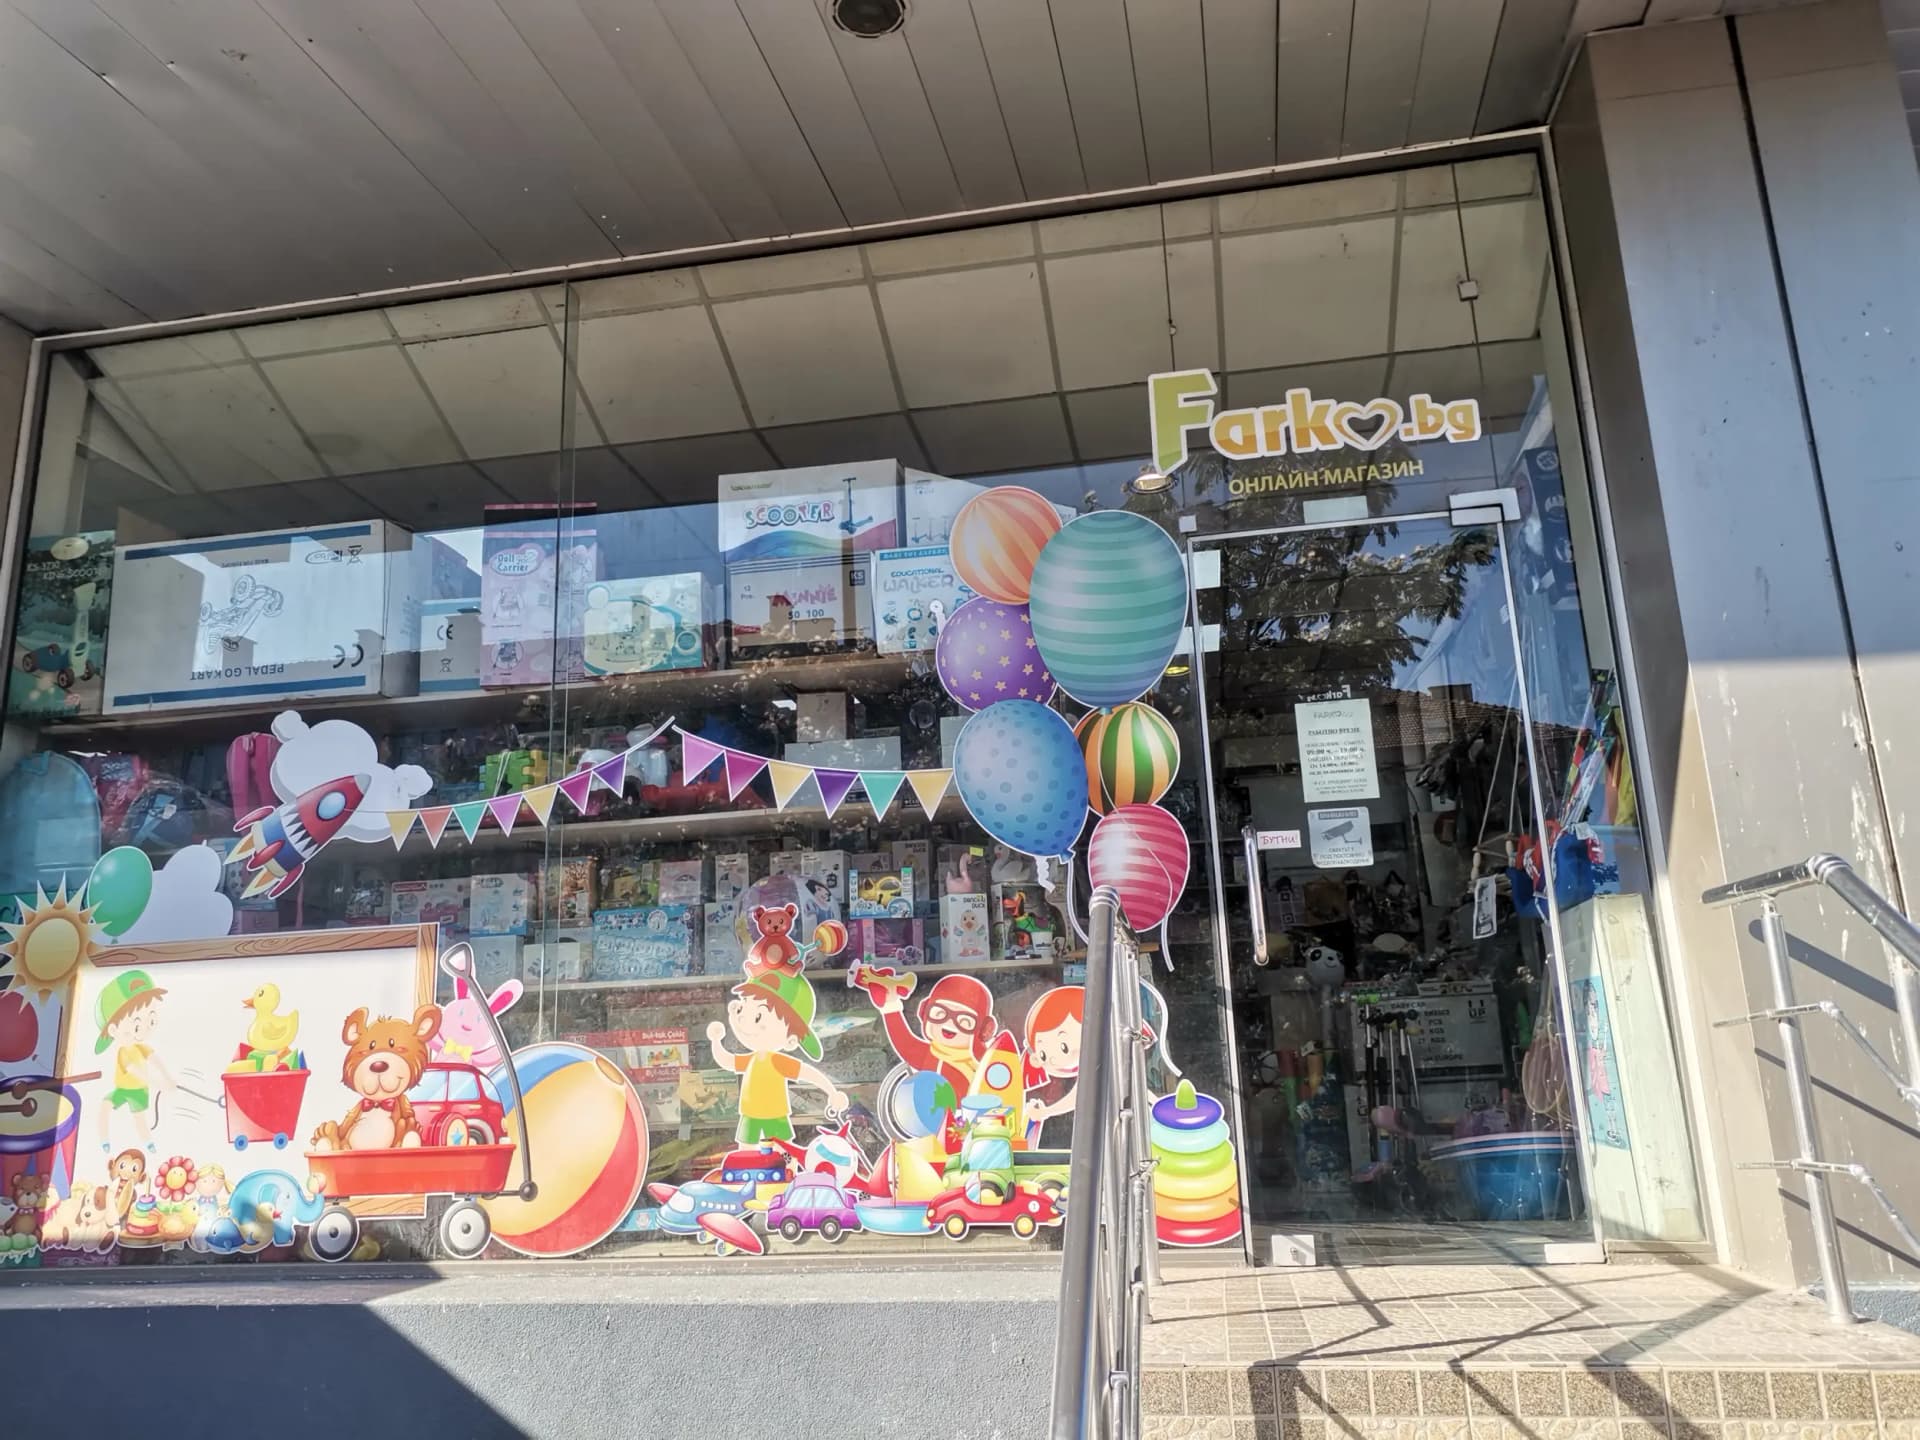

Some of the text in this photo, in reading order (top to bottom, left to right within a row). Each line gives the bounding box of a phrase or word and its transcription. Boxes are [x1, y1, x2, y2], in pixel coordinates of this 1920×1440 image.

[1229, 460, 1424, 495] ОНЛАЙН МАГАЗИН
[744, 501, 835, 528] SCOOTER
[497, 553, 515, 563] Doll
[497, 562, 529, 573] Carrier
[890, 567, 945, 578] EDUCATIONAL
[884, 574, 954, 594] WALKER
[772, 585, 838, 608] MINNIE
[806, 608, 825, 619] 100
[190, 663, 285, 681] PEDAL GO KART
[1468, 1008, 1487, 1018] UP
